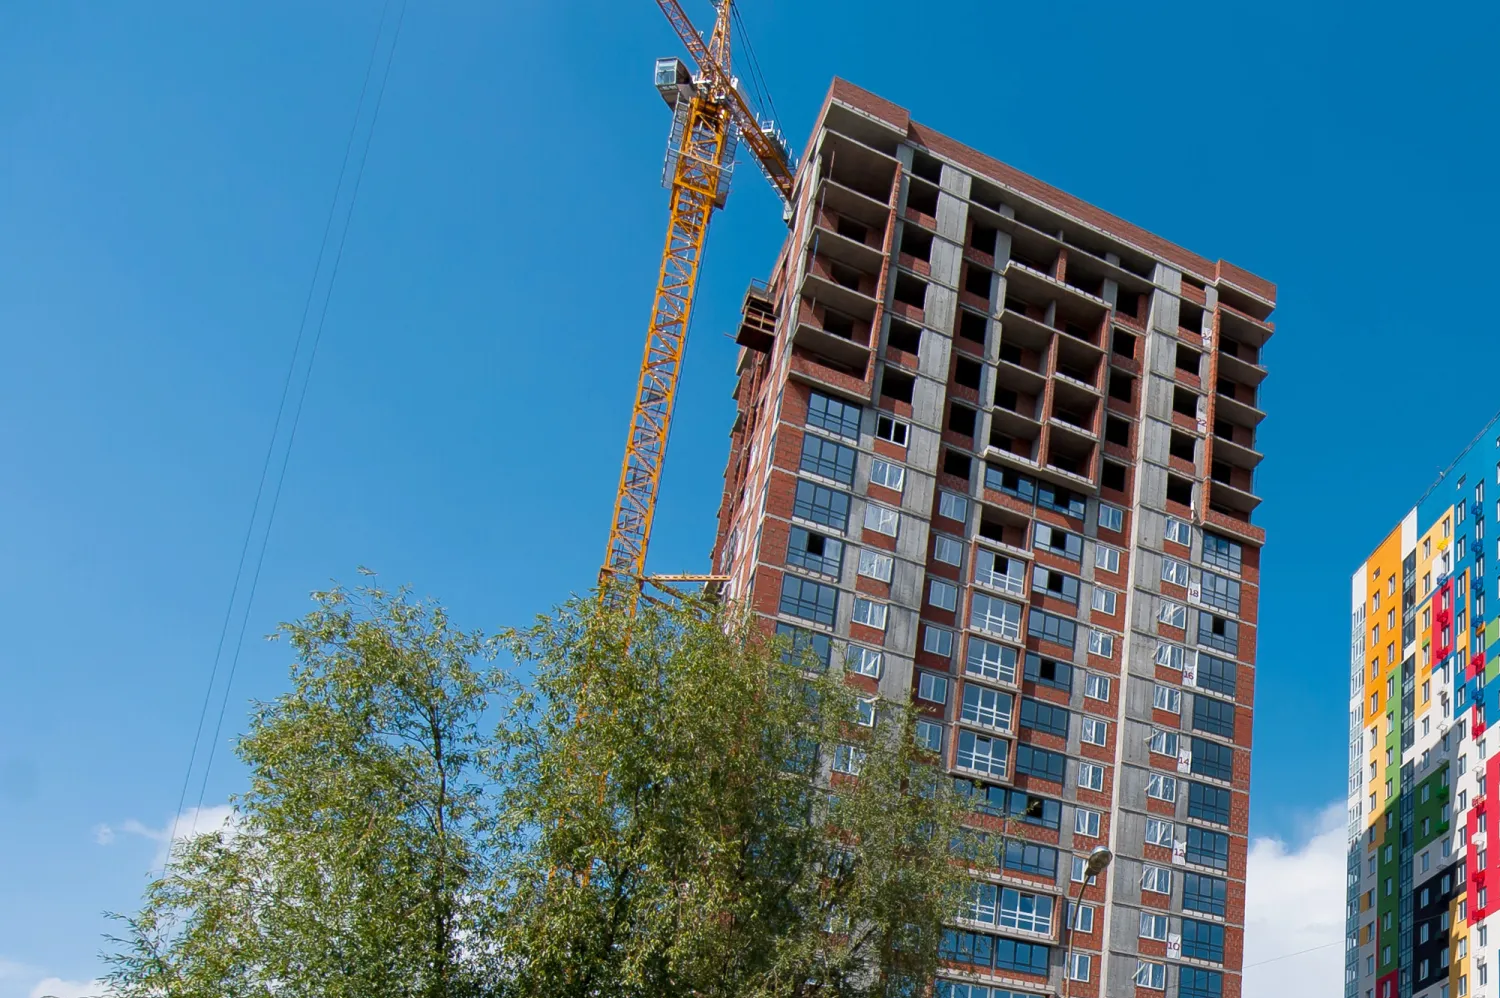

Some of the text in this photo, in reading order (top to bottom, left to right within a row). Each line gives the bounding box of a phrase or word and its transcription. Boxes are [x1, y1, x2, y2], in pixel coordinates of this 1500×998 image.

[1197, 418, 1207, 427] 22
[1190, 588, 1198, 598] 18
[1183, 671, 1194, 680] 16
[1179, 757, 1189, 766] 14
[1174, 848, 1184, 858] 12
[1167, 942, 1180, 951] 10
